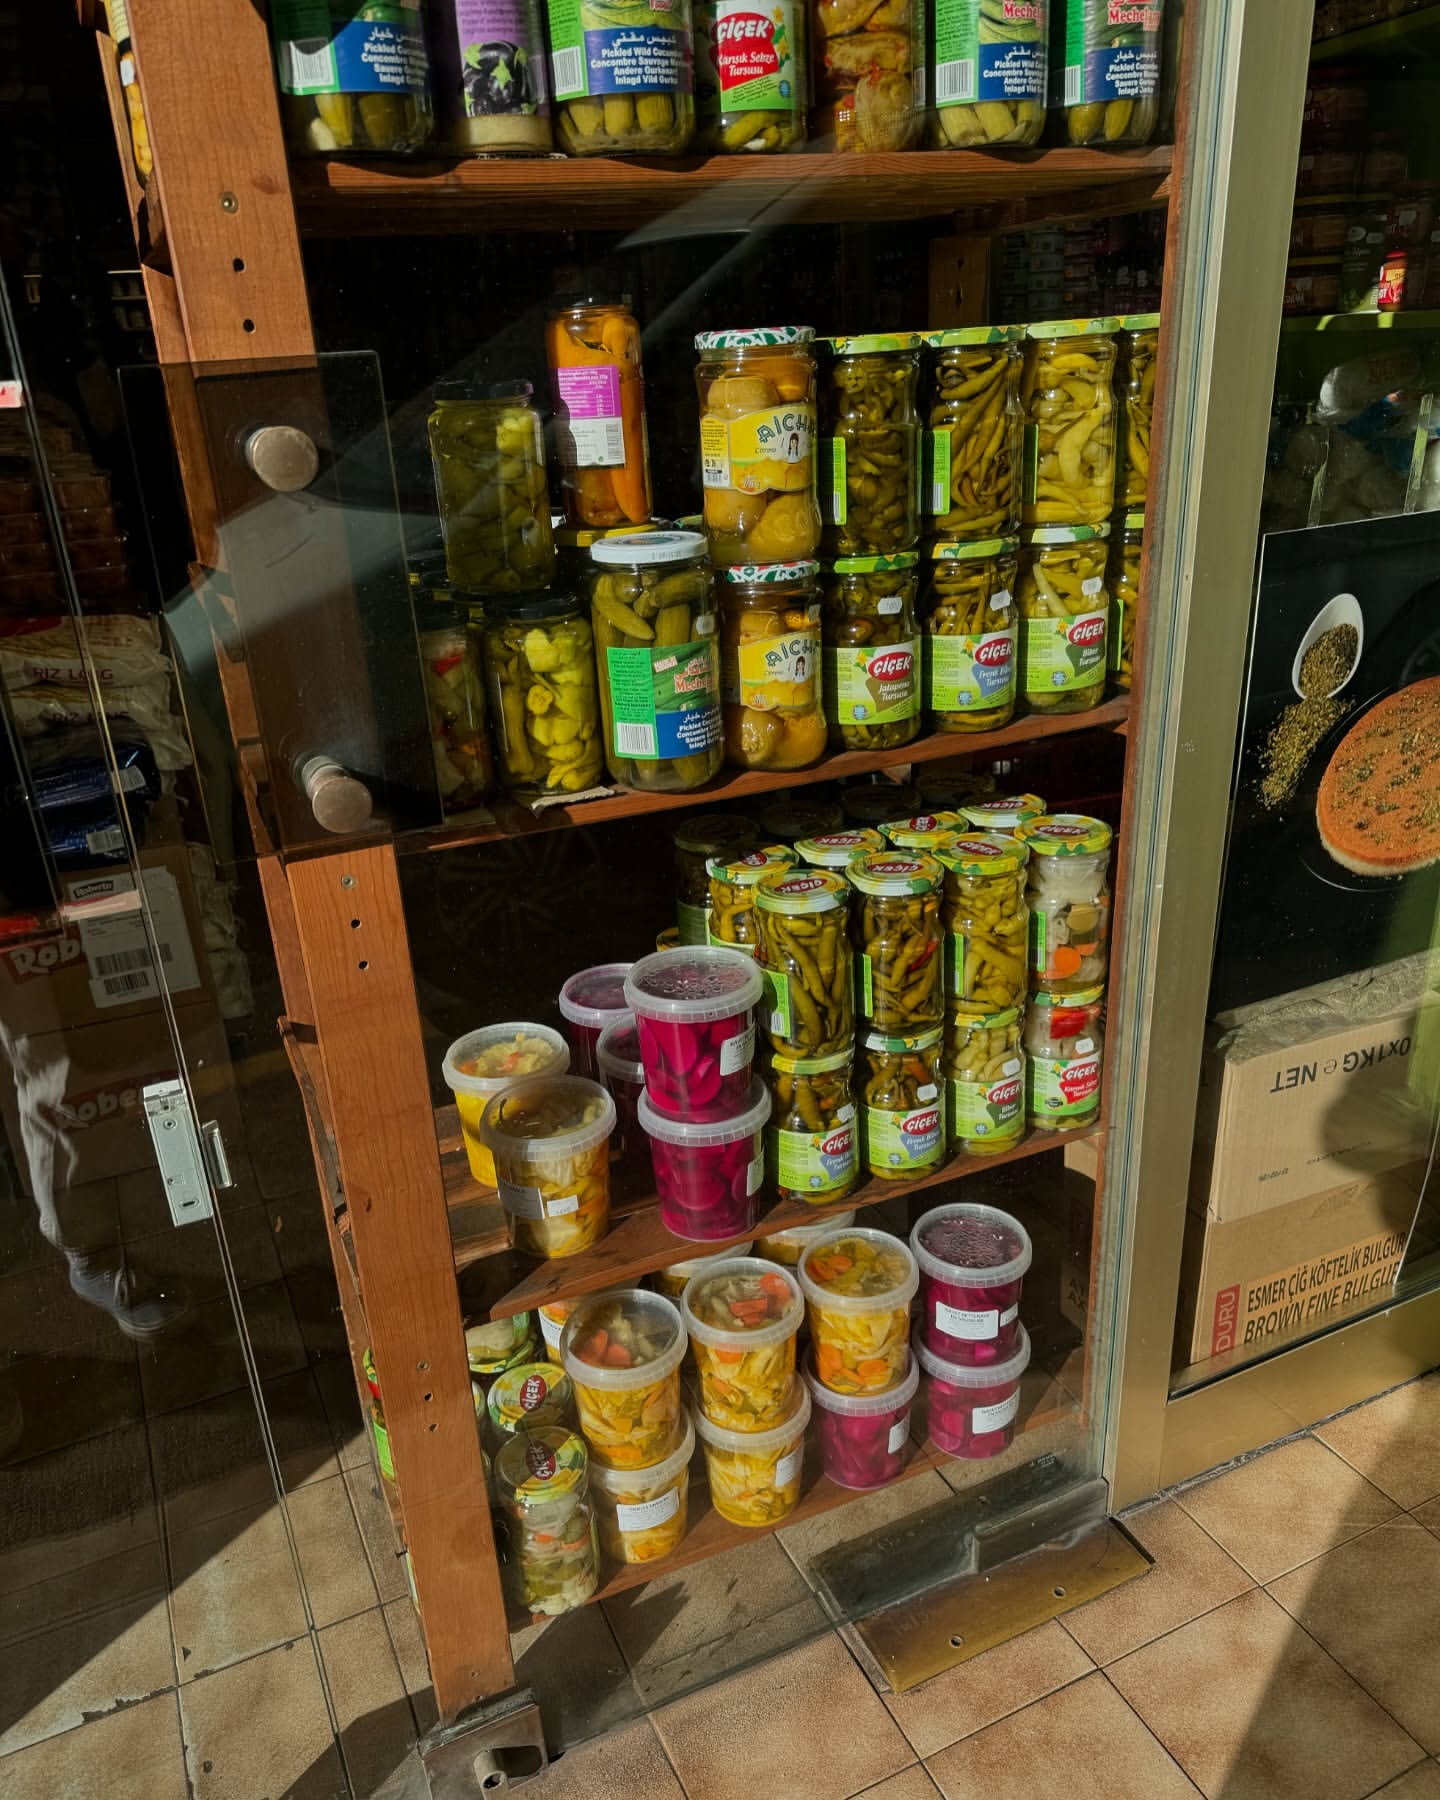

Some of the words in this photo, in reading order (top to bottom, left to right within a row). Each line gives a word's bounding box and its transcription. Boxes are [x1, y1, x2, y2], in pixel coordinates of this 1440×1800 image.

[717, 18, 770, 43] ÇİÇEK
[363, 42, 396, 54] Pickled
[601, 46, 633, 59] Pickled
[633, 46, 652, 57] Wild
[591, 58, 638, 69] Concombre
[749, 51, 775, 64] Sebze
[613, 66, 643, 76] Andere
[994, 60, 1021, 70] Pickled
[1108, 63, 1135, 73] Pickled
[615, 75, 642, 87] Inlagd
[873, 655, 912, 677] ÇİÇEK
[33, 667, 60, 680] RIZ
[1269, 1061, 1318, 1094] NET
[1246, 1278, 1287, 1313] ESMER
[1288, 1266, 1308, 1300] ÇİĞ
[1308, 1244, 1363, 1289] KÖFTELİK
[1244, 1300, 1305, 1345] BROWN
[1306, 1285, 1341, 1319] FINE
[1215, 1291, 1236, 1353] DURU
